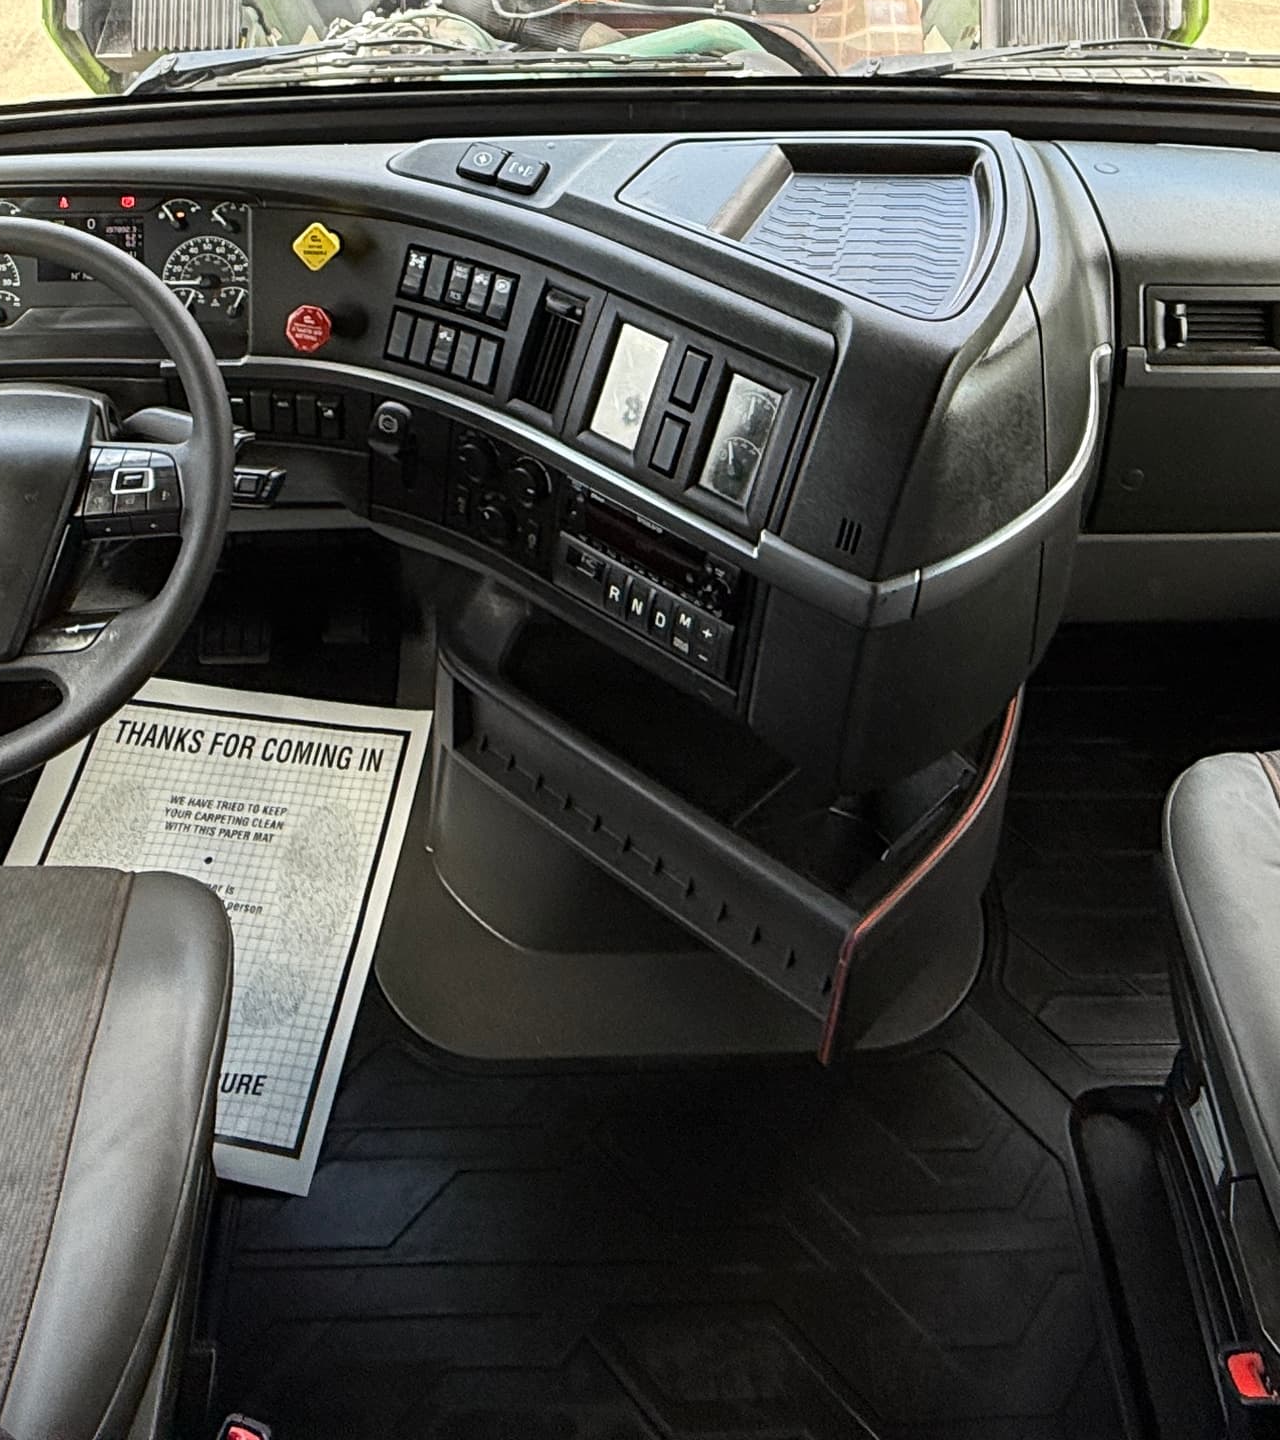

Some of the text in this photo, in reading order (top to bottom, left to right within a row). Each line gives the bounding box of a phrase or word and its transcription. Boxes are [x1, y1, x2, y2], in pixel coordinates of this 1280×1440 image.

[608, 585, 621, 602] R
[631, 598, 644, 616] N
[654, 612, 666, 628] D
[679, 613, 692, 628] M
[115, 720, 385, 773] THANKS FOR COMING IN
[170, 794, 288, 816] WE HAVE TRIED TO KEEP
[164, 807, 285, 830] YOUR CARPETING CLEAN
[164, 821, 275, 843] WITH THIS PAPER MAT
[225, 883, 235, 895] is
[226, 901, 263, 914] person
[221, 1072, 268, 1097] URE
